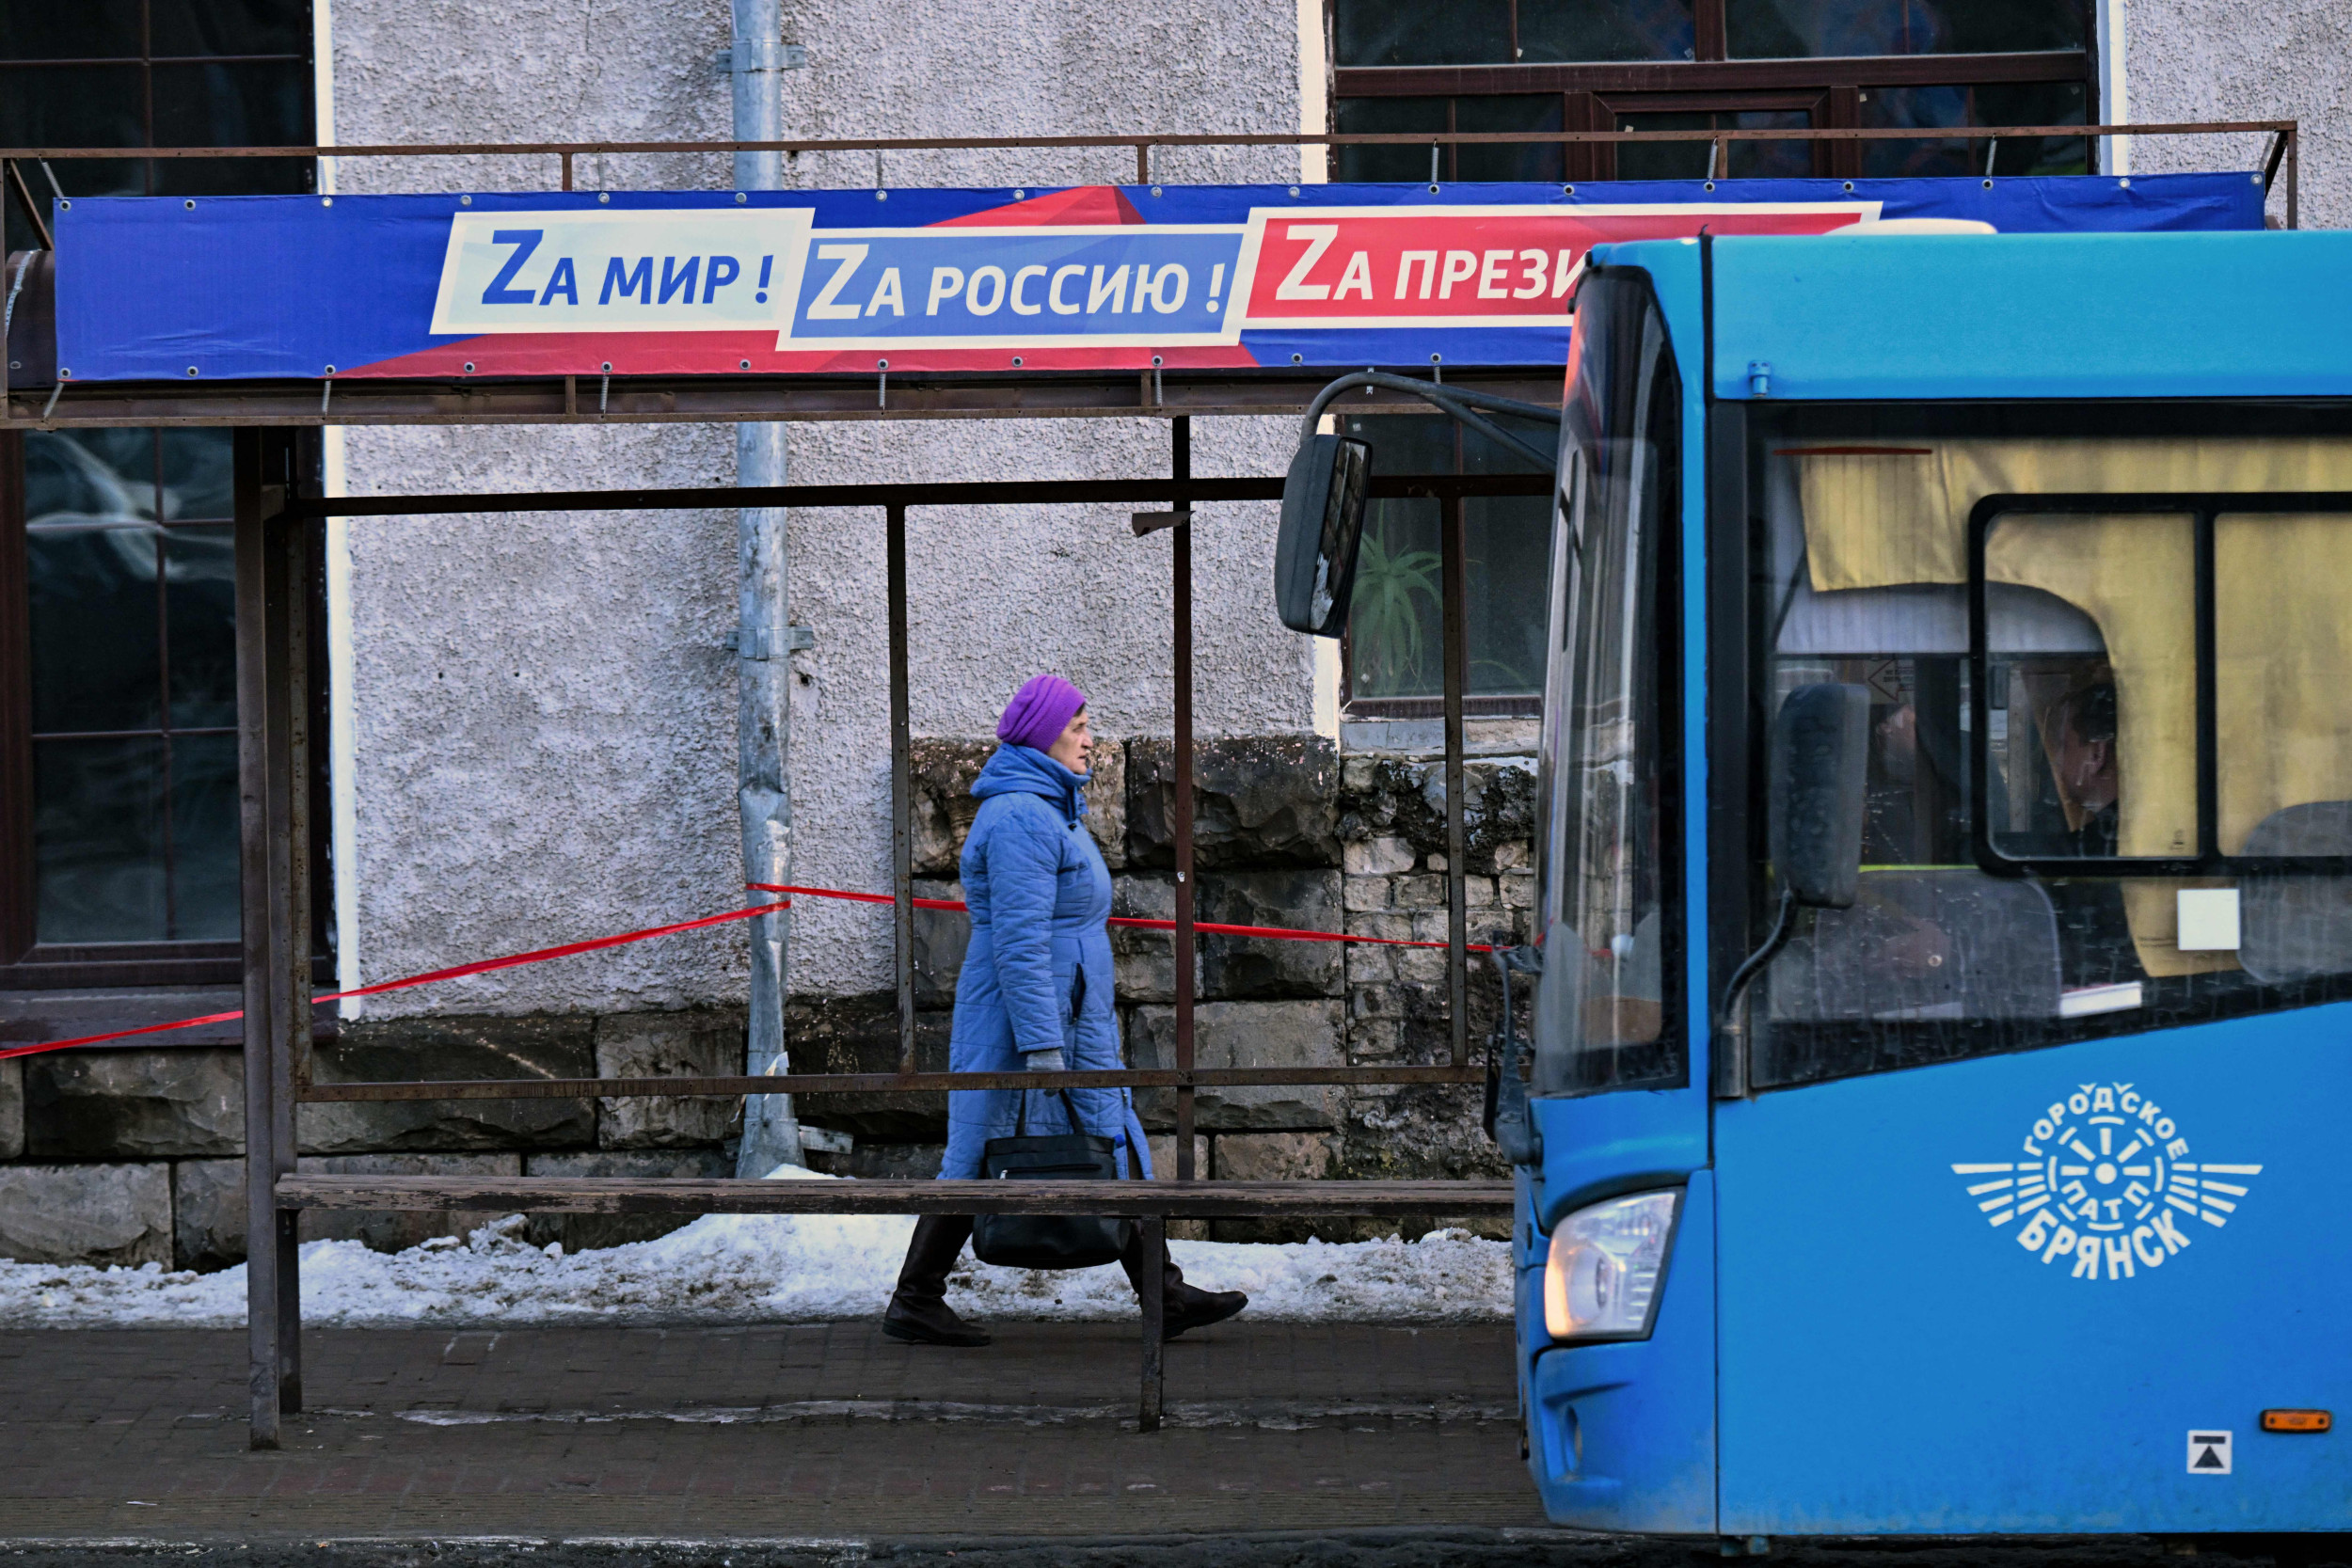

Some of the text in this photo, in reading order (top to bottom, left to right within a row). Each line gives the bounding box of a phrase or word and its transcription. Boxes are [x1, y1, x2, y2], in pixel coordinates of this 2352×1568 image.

[597, 254, 740, 306] МИР
[926, 263, 1191, 317] РОССИЮ
[2024, 1087, 2189, 1161] ГОРОДСКОЕ
[2060, 1180, 2151, 1221] ПАТП
[2016, 1208, 2191, 1280] БРЯНСК
